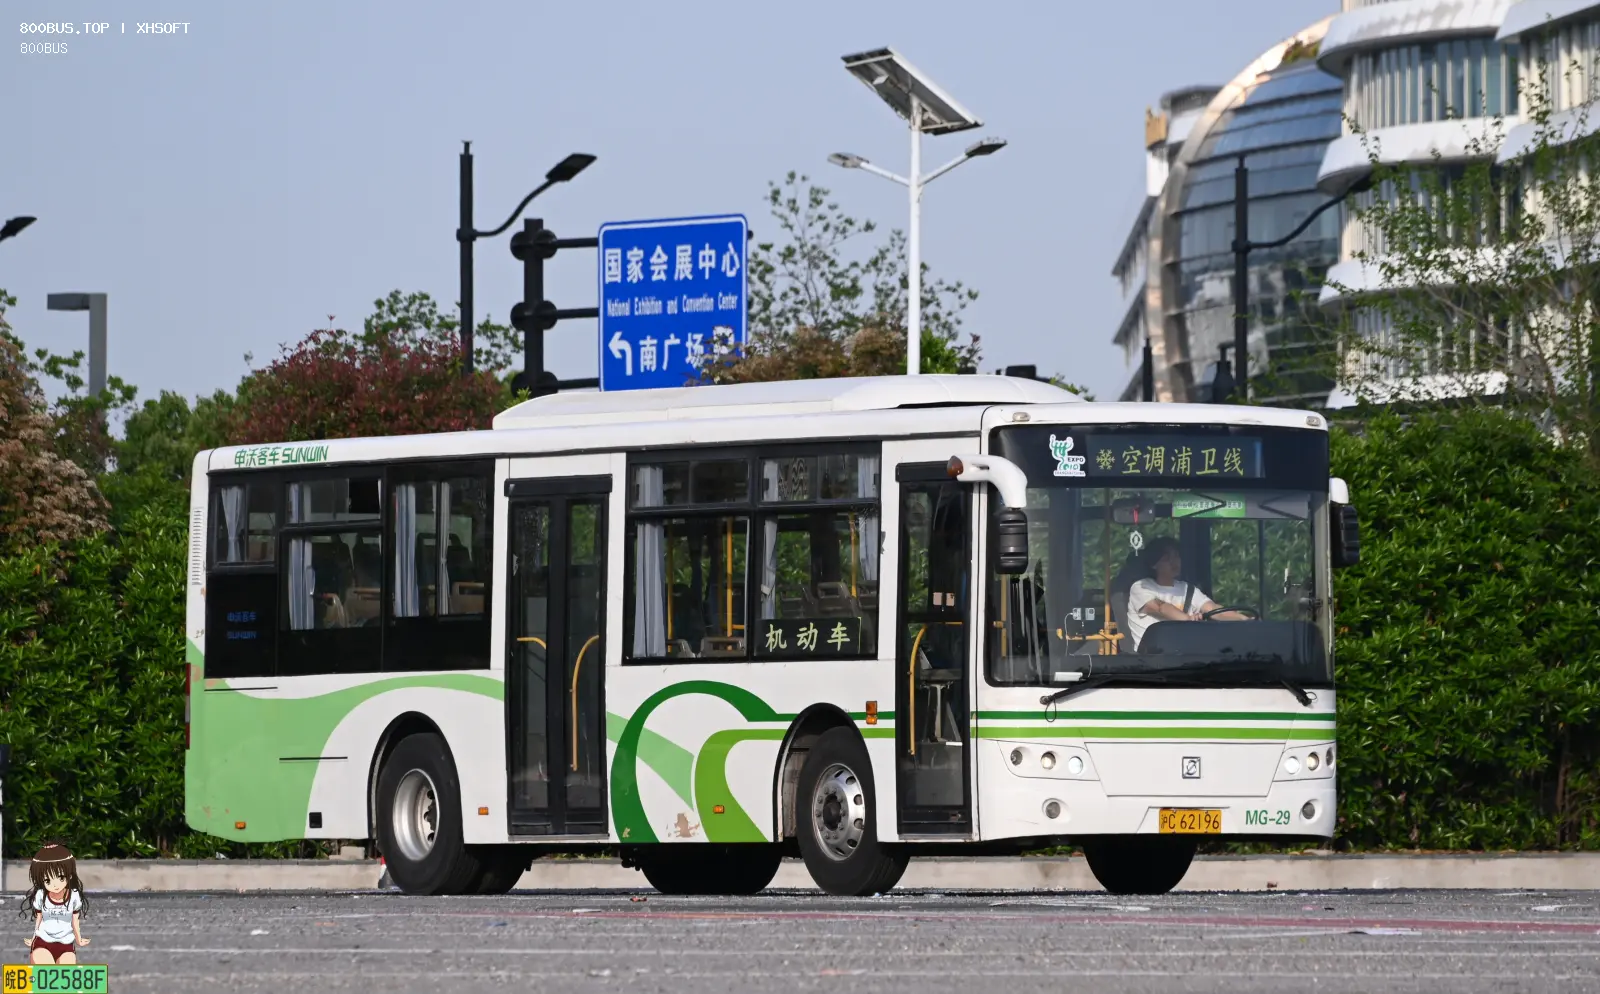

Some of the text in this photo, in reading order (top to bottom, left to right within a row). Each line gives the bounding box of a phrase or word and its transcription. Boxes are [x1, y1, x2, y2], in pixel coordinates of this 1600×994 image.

[604, 241, 741, 285] 国家会展中心
[607, 291, 738, 317] National Exhibition and Convention Center
[638, 332, 705, 373] 南广场
[234, 445, 329, 467] 申沃客车 SUNWIN
[1121, 445, 1244, 476] 空调浦卫线
[765, 621, 851, 652] 机动车
[1179, 813, 1220, 830] 62196
[1245, 809, 1291, 825] MG-29
